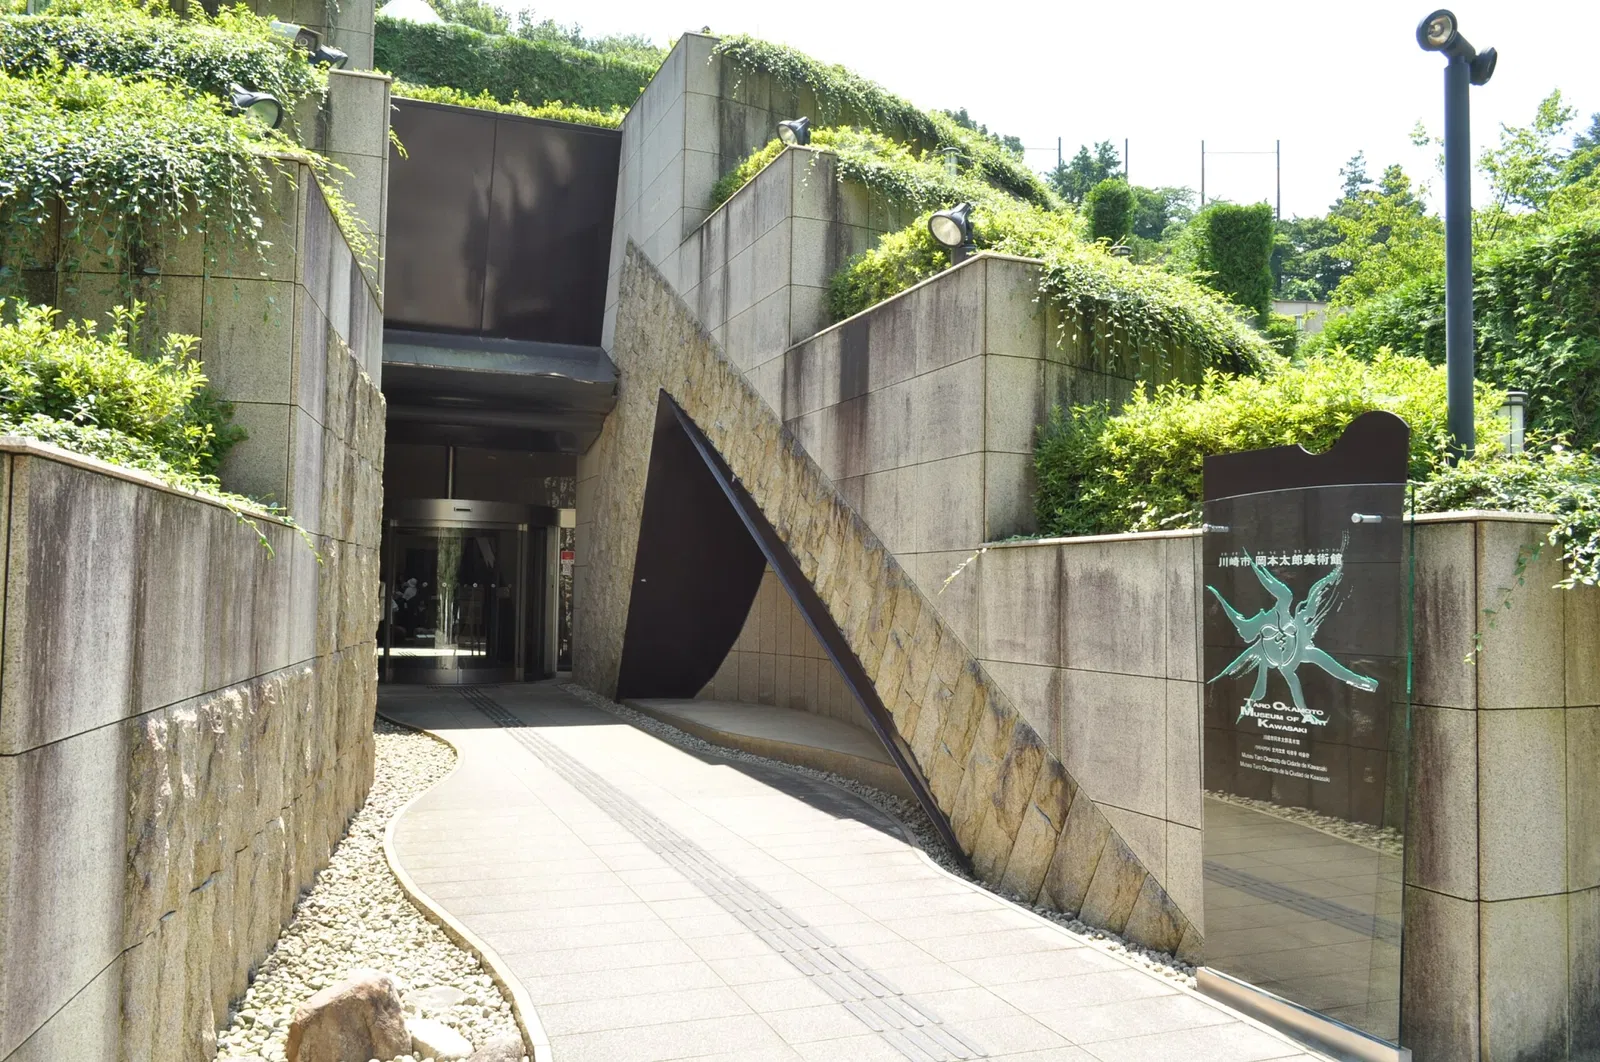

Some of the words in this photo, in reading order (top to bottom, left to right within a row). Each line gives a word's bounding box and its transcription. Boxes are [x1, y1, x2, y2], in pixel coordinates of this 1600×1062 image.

[1218, 556, 1250, 568] 川崎市
[1256, 553, 1343, 566] 岡本太郎美術館
